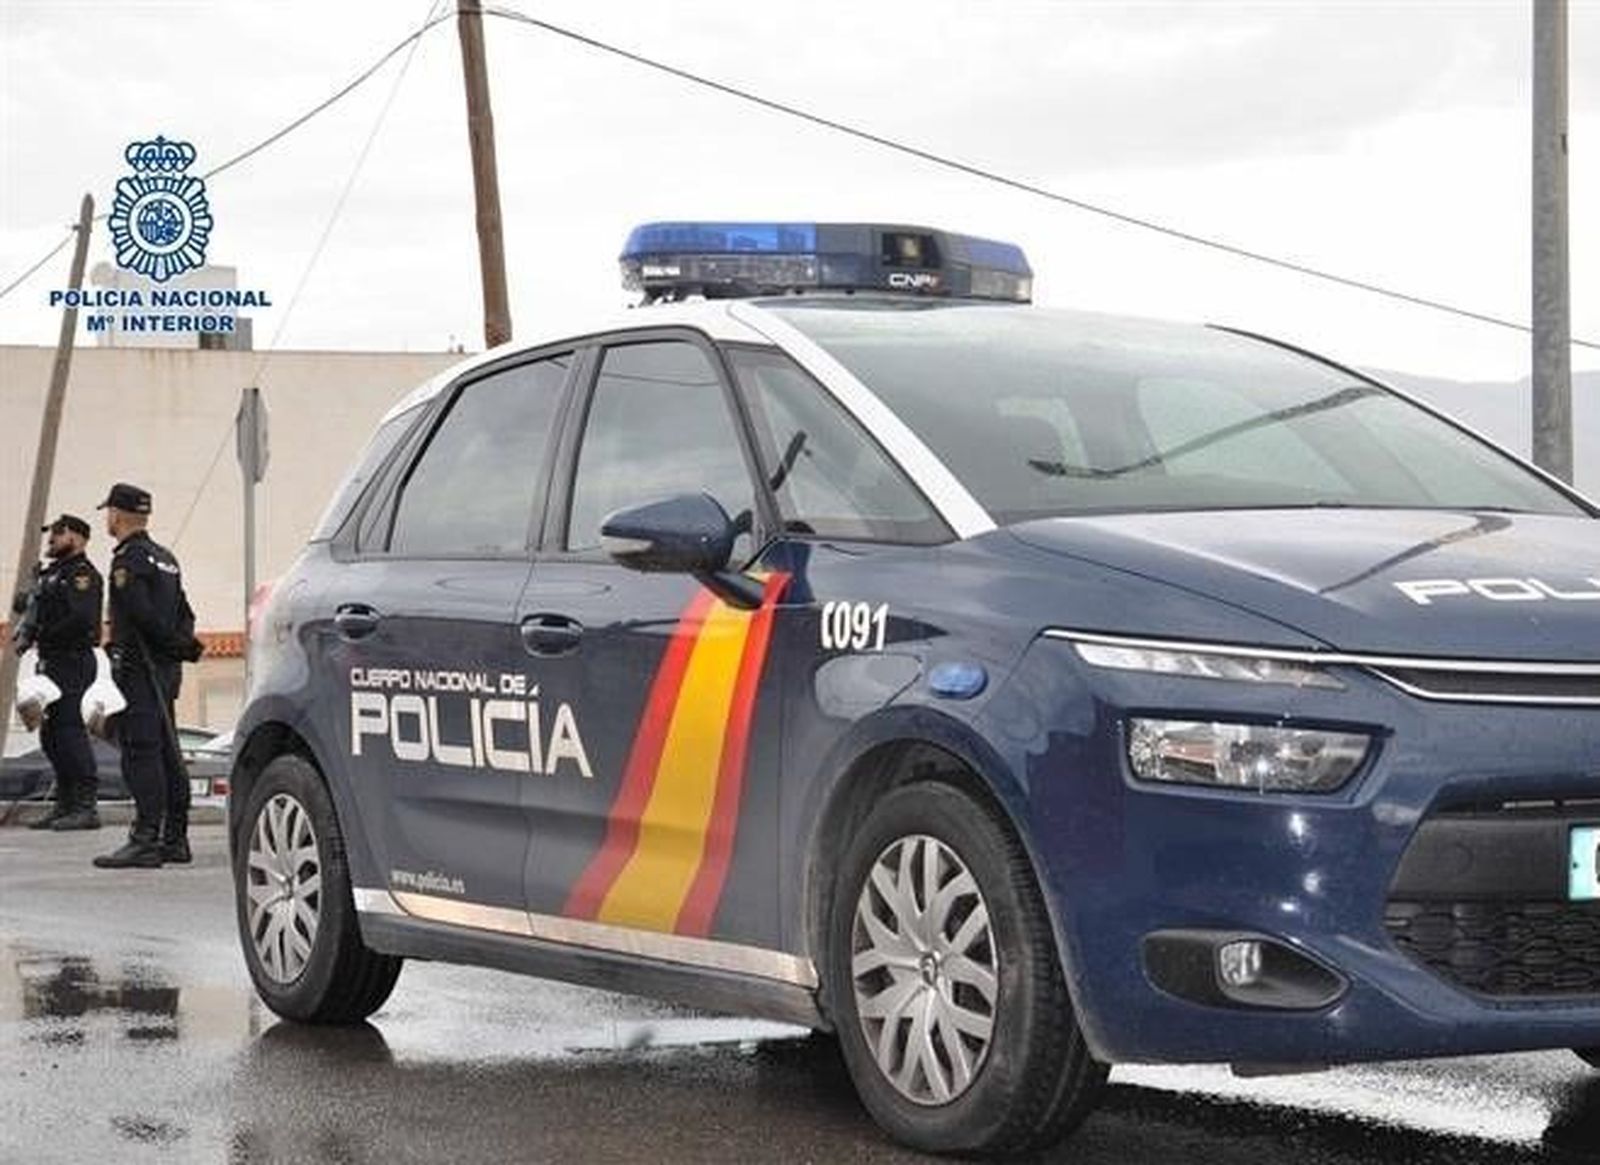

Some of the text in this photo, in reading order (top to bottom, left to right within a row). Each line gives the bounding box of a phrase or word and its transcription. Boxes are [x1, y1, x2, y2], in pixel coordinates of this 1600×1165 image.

[351, 668, 525, 694] CUERPO NACIONAL DE
[351, 684, 593, 777] POLICÍA
